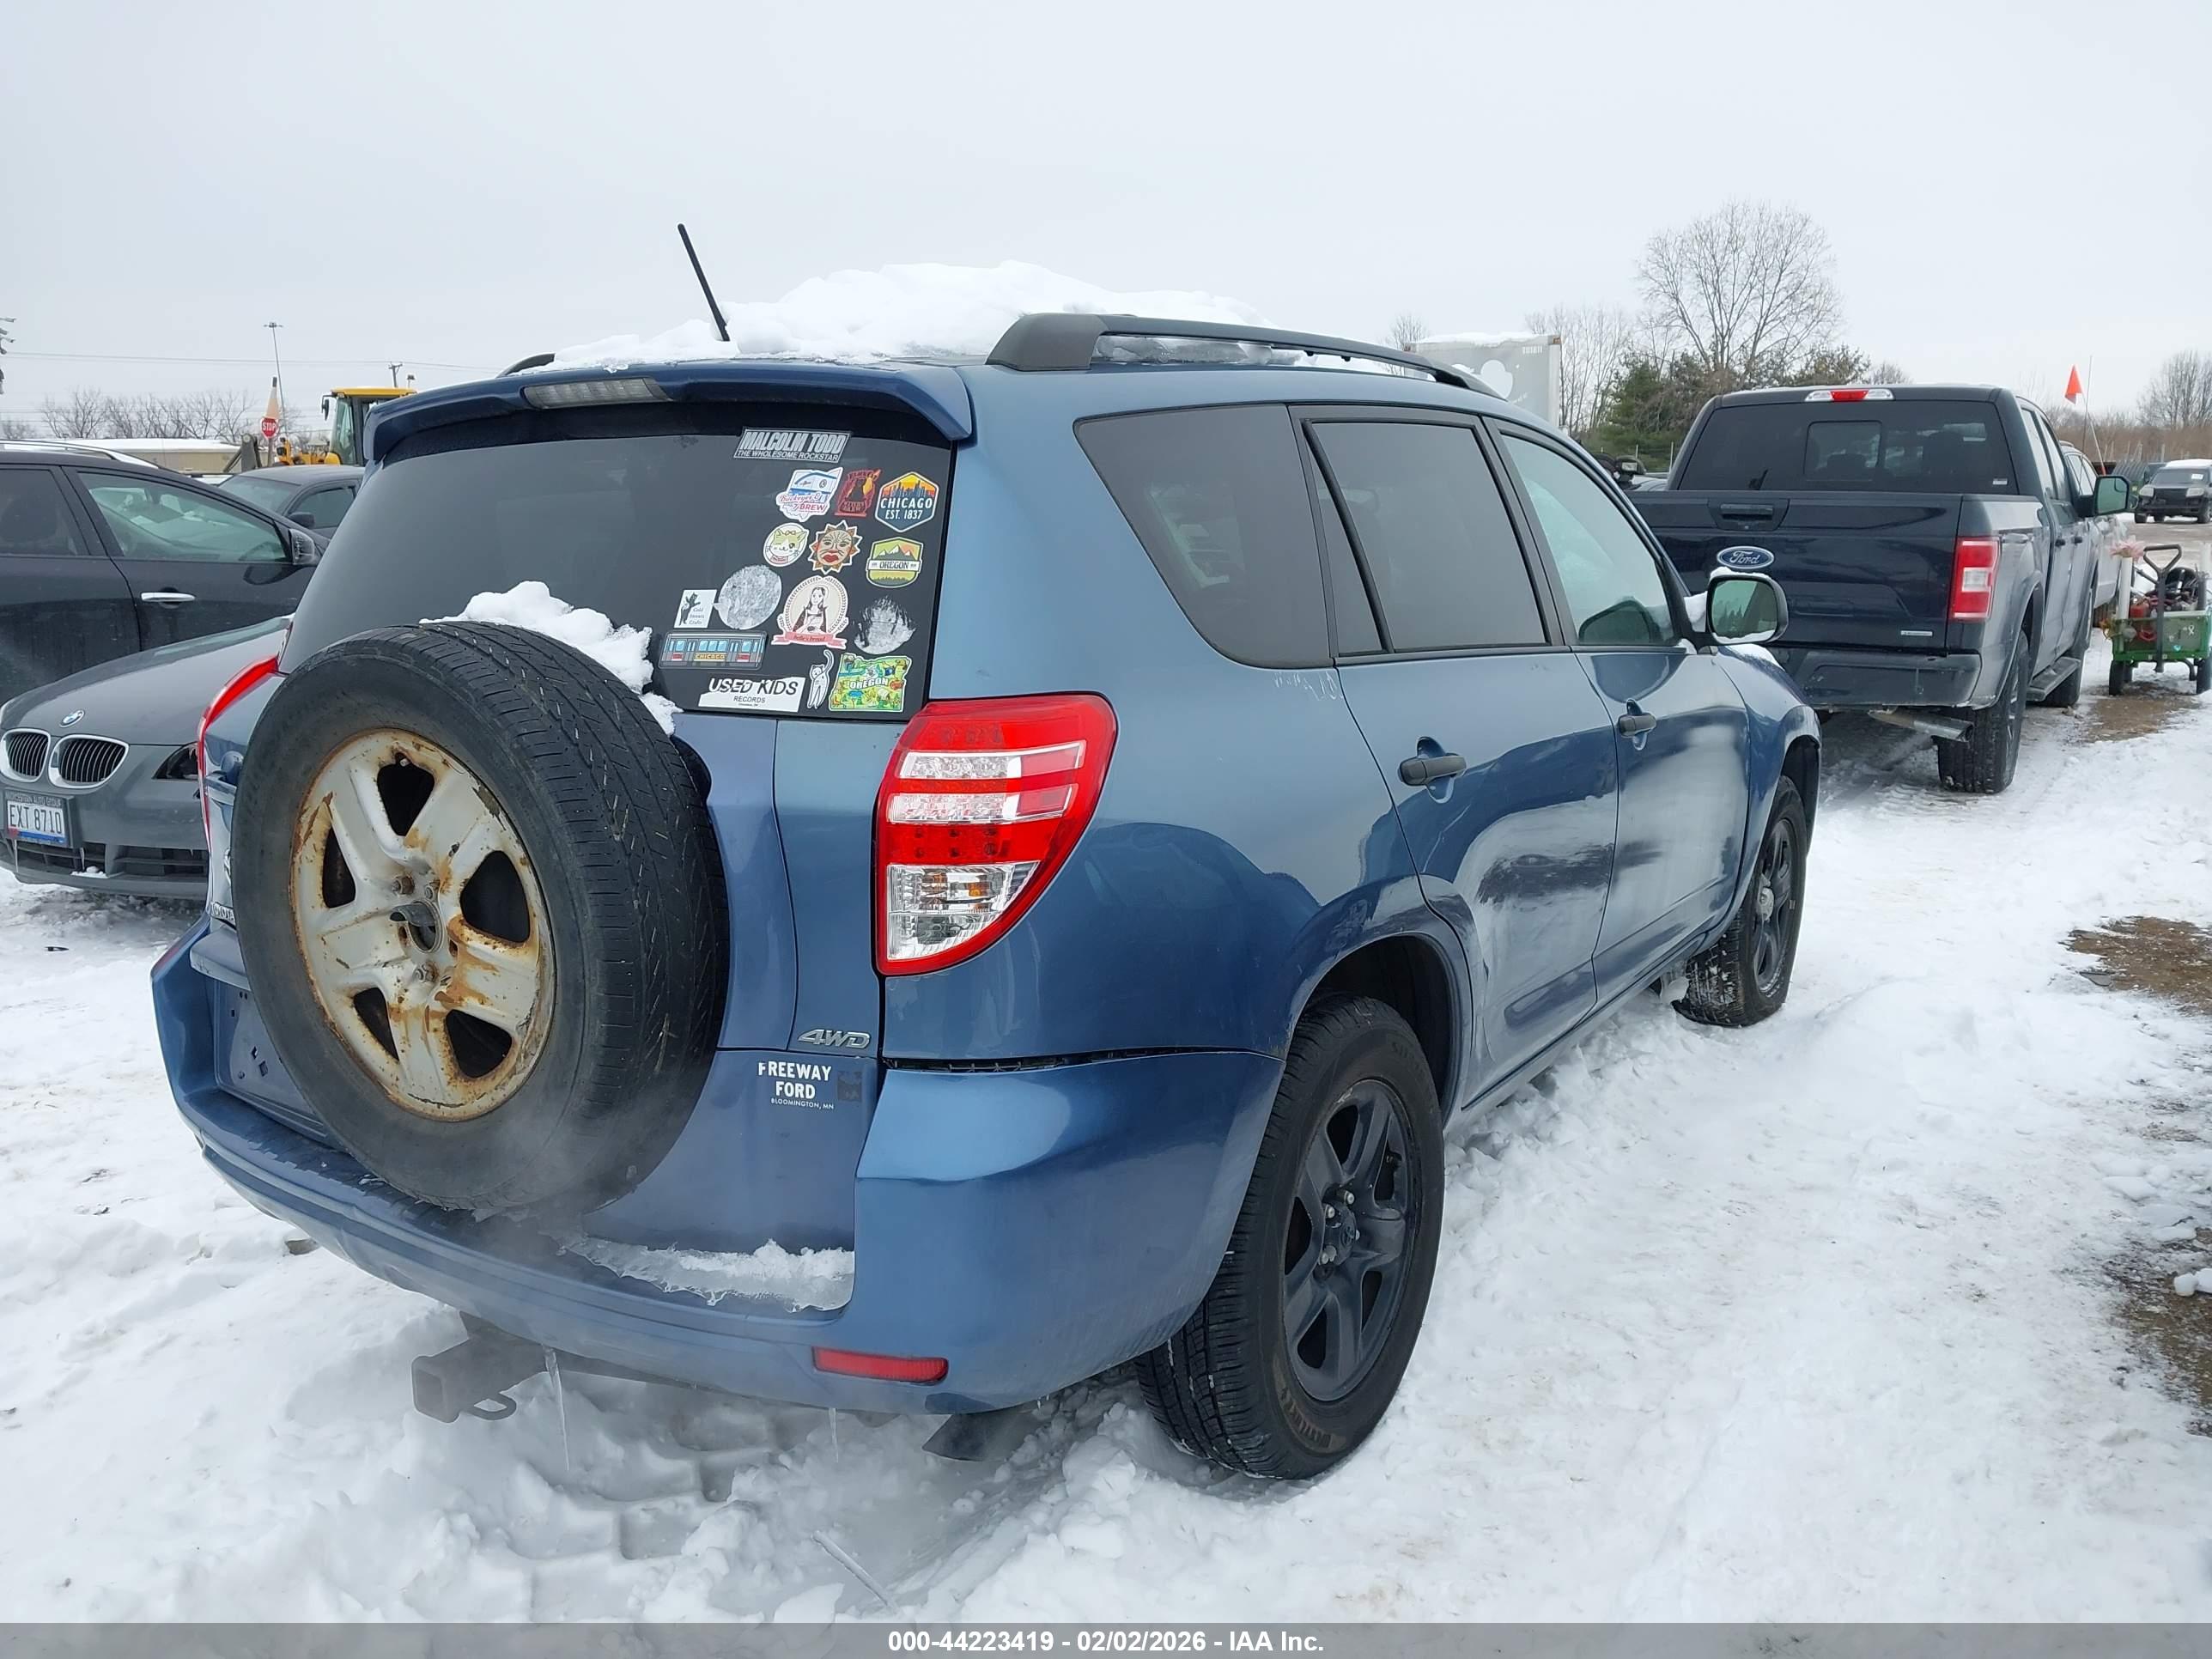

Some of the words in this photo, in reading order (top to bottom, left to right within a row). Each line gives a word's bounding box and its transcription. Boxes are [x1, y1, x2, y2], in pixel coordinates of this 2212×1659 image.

[262, 422, 276, 431] STOP
[739, 431, 809, 452] MALCOLM
[807, 434, 847, 454] TODD
[799, 453, 839, 462] ROCKSTAR
[880, 497, 933, 509] CHICAGO
[885, 509, 901, 520] EST.
[903, 509, 923, 520] 1837
[1729, 550, 1761, 564] Ford
[879, 561, 909, 569] OREGON
[708, 678, 753, 693] USED
[757, 679, 799, 696] KIDS
[849, 677, 889, 690] OREGON
[9, 804, 29, 830] EXT
[34, 808, 63, 835] 8710
[797, 1029, 871, 1049] 4WD
[758, 1060, 832, 1081] FREEWAY
[775, 1080, 816, 1099] FORD
[770, 1097, 822, 1110] BLOOMINGTON,
